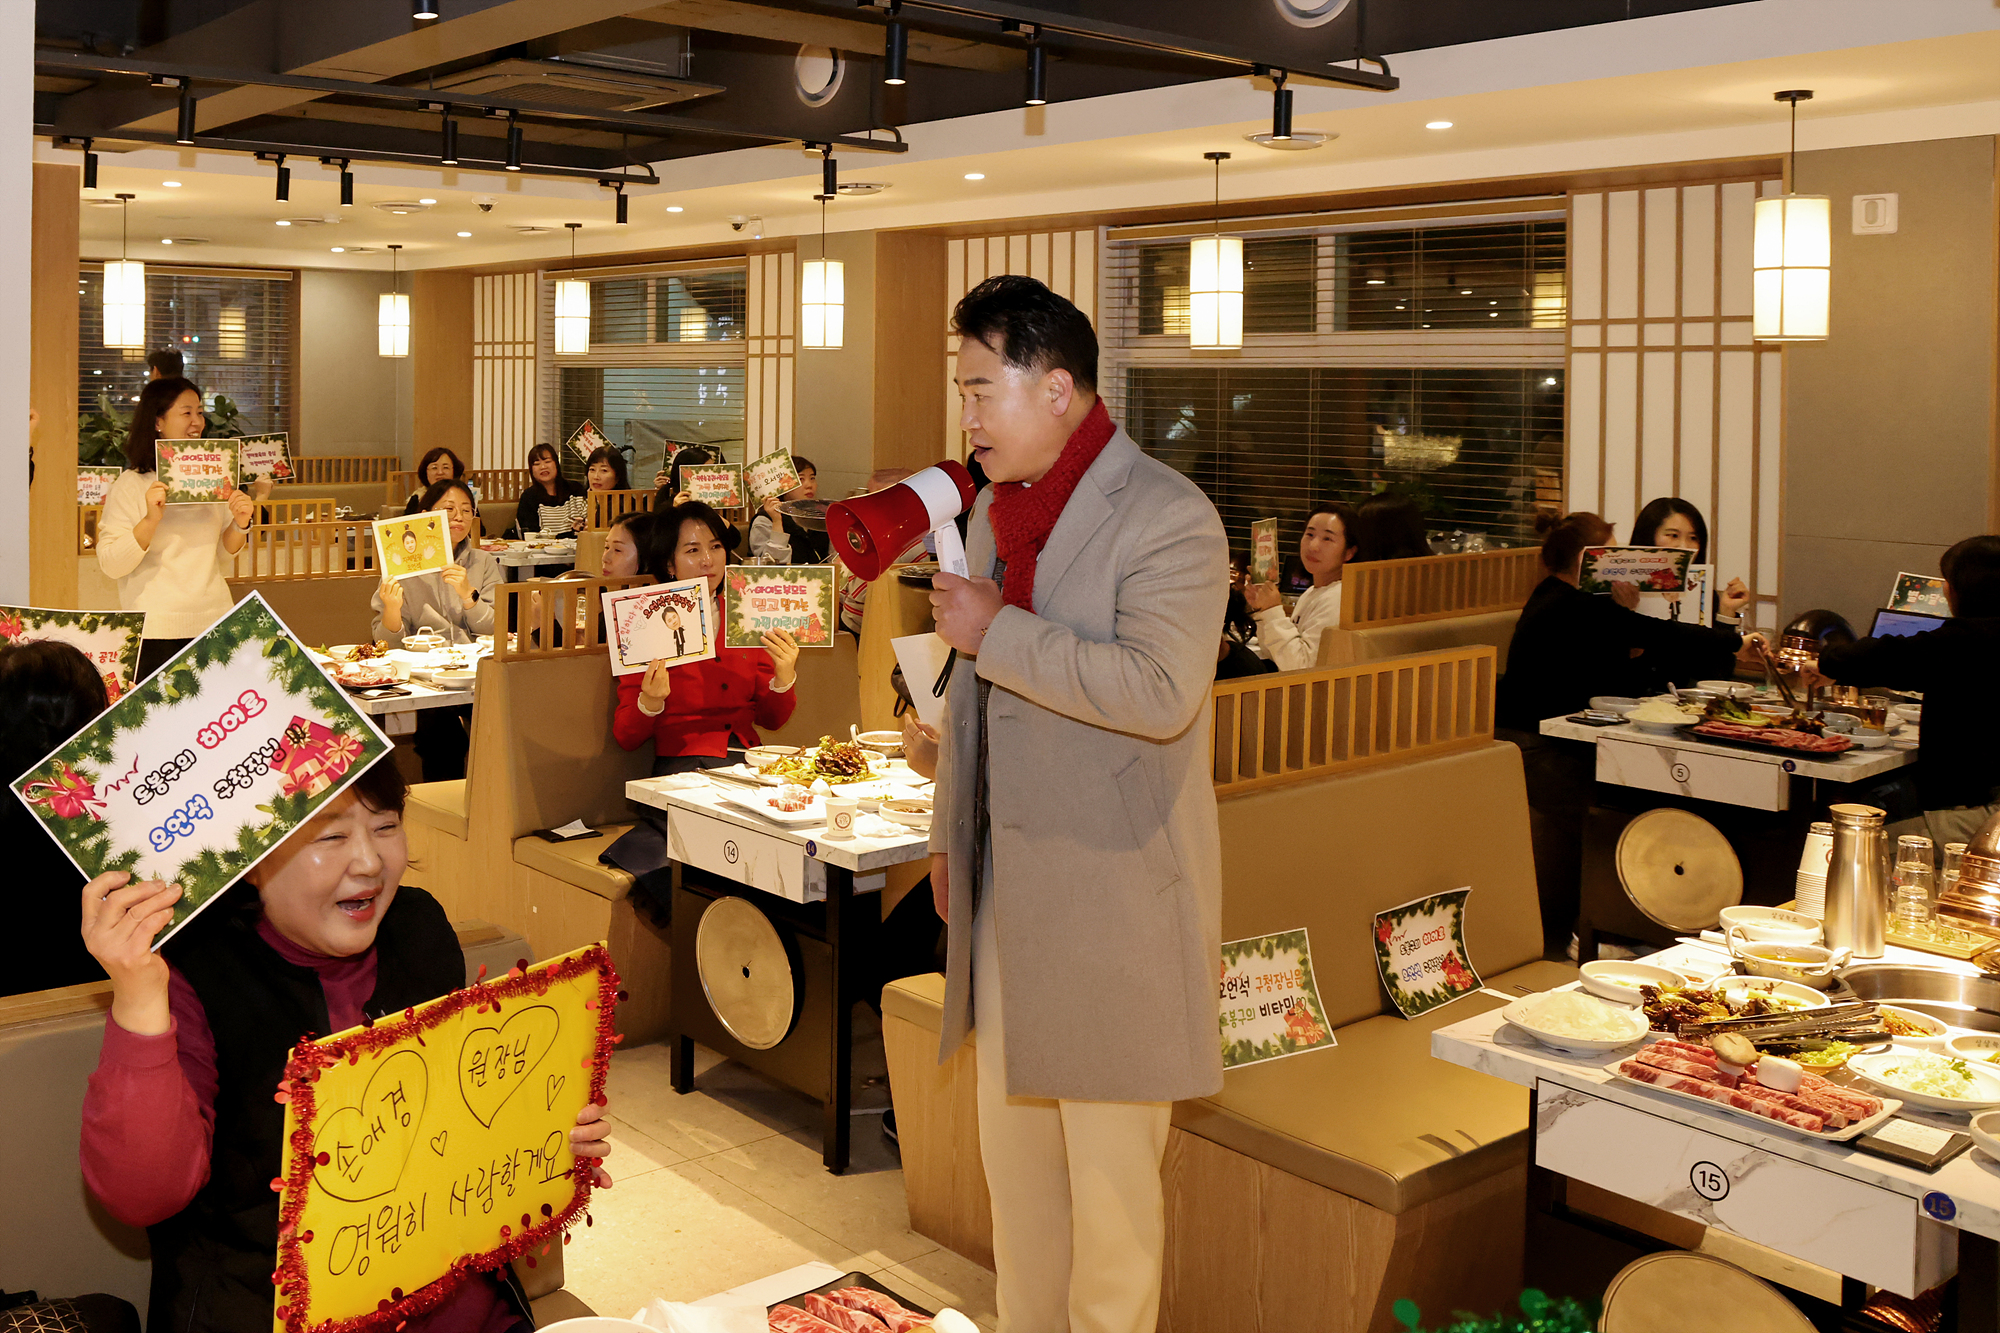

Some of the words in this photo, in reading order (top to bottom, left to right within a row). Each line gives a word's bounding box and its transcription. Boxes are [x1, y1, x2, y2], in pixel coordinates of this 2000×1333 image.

[180, 464, 201, 475] 믿고
[196, 478, 224, 489] 어린이집
[783, 584, 807, 595] 부모도
[751, 598, 779, 612] 믿고
[781, 598, 809, 612] 맡기는
[751, 615, 771, 629] 가정
[772, 615, 810, 629] 어린이집
[98, 651, 118, 664] 공간
[133, 748, 197, 805] 도봉구의
[196, 689, 267, 750] 히어로
[1677, 768, 1684, 777] 5
[149, 794, 213, 852] 오언석
[213, 738, 286, 799] 구청장님
[727, 846, 736, 858] 14
[1422, 925, 1446, 945] 히어로
[1402, 962, 1423, 982] 오언석
[1220, 975, 1250, 1000] 오언석
[1255, 968, 1304, 993] 구청장님은
[1259, 995, 1296, 1017] 비타민
[468, 1034, 530, 1087] 원장님
[337, 1080, 411, 1183] 손애경
[1699, 1170, 1721, 1192] 15
[328, 1192, 427, 1276] 영원히
[449, 1130, 569, 1217] 사랑할게요
[1929, 1197, 1951, 1216] 15
